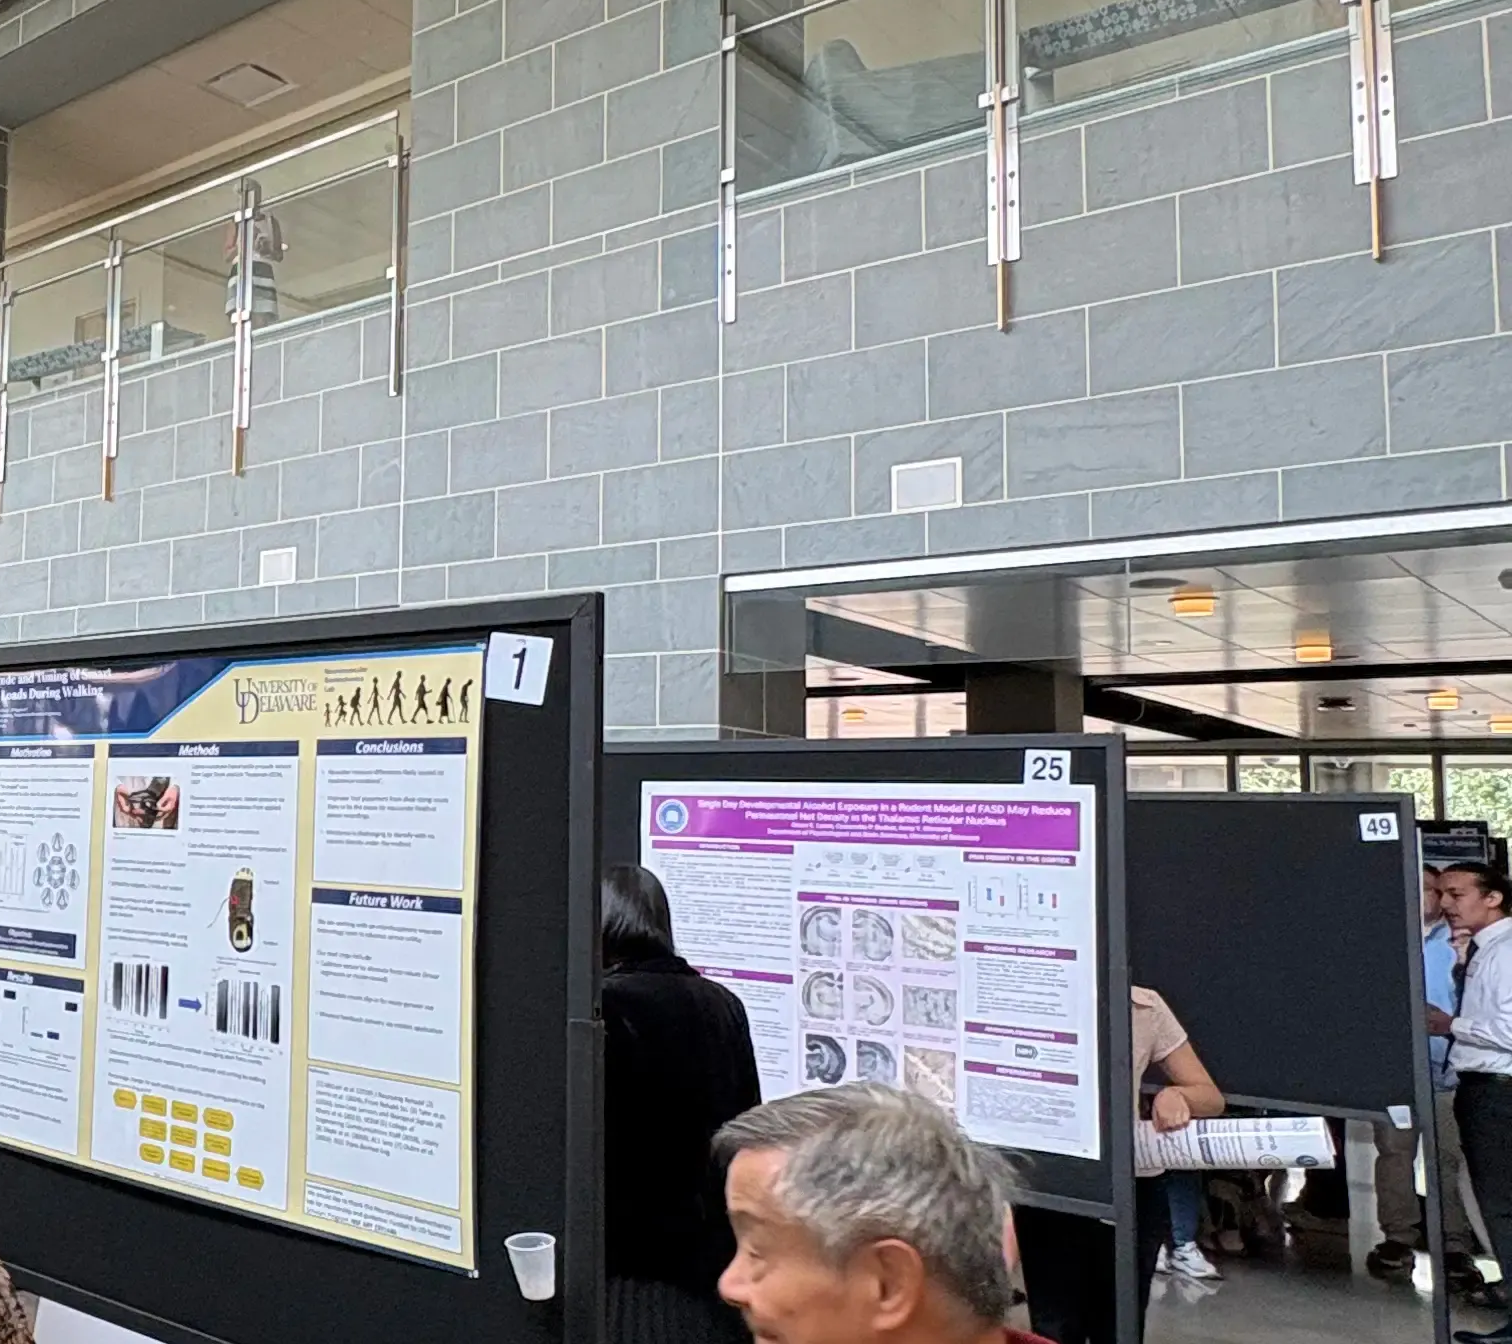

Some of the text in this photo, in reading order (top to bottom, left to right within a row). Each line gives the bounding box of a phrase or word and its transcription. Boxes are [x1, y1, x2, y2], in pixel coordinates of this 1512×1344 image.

[512, 647, 527, 690] 1
[17, 673, 34, 685] and
[36, 671, 69, 686] Timing
[70, 669, 81, 681] of
[1, 689, 27, 702] Loads
[29, 687, 61, 701] During
[62, 685, 104, 700] Walking
[238, 692, 317, 724] DELAWARE
[178, 743, 220, 756] Methods
[355, 740, 424, 754] Conclusions
[1031, 756, 1064, 782] 25
[803, 801, 835, 811] Alcohol
[837, 802, 879, 813] Exposure
[898, 803, 932, 813] Rodent
[934, 804, 964, 813] Model
[965, 804, 977, 814] of
[978, 805, 1005, 815] FASD
[1007, 806, 1029, 816] May
[1031, 807, 1072, 816] Reduce
[817, 812, 849, 823] Density
[966, 816, 1007, 826] Nucleus
[1367, 818, 1392, 835] 49
[349, 892, 424, 910] Future Work
